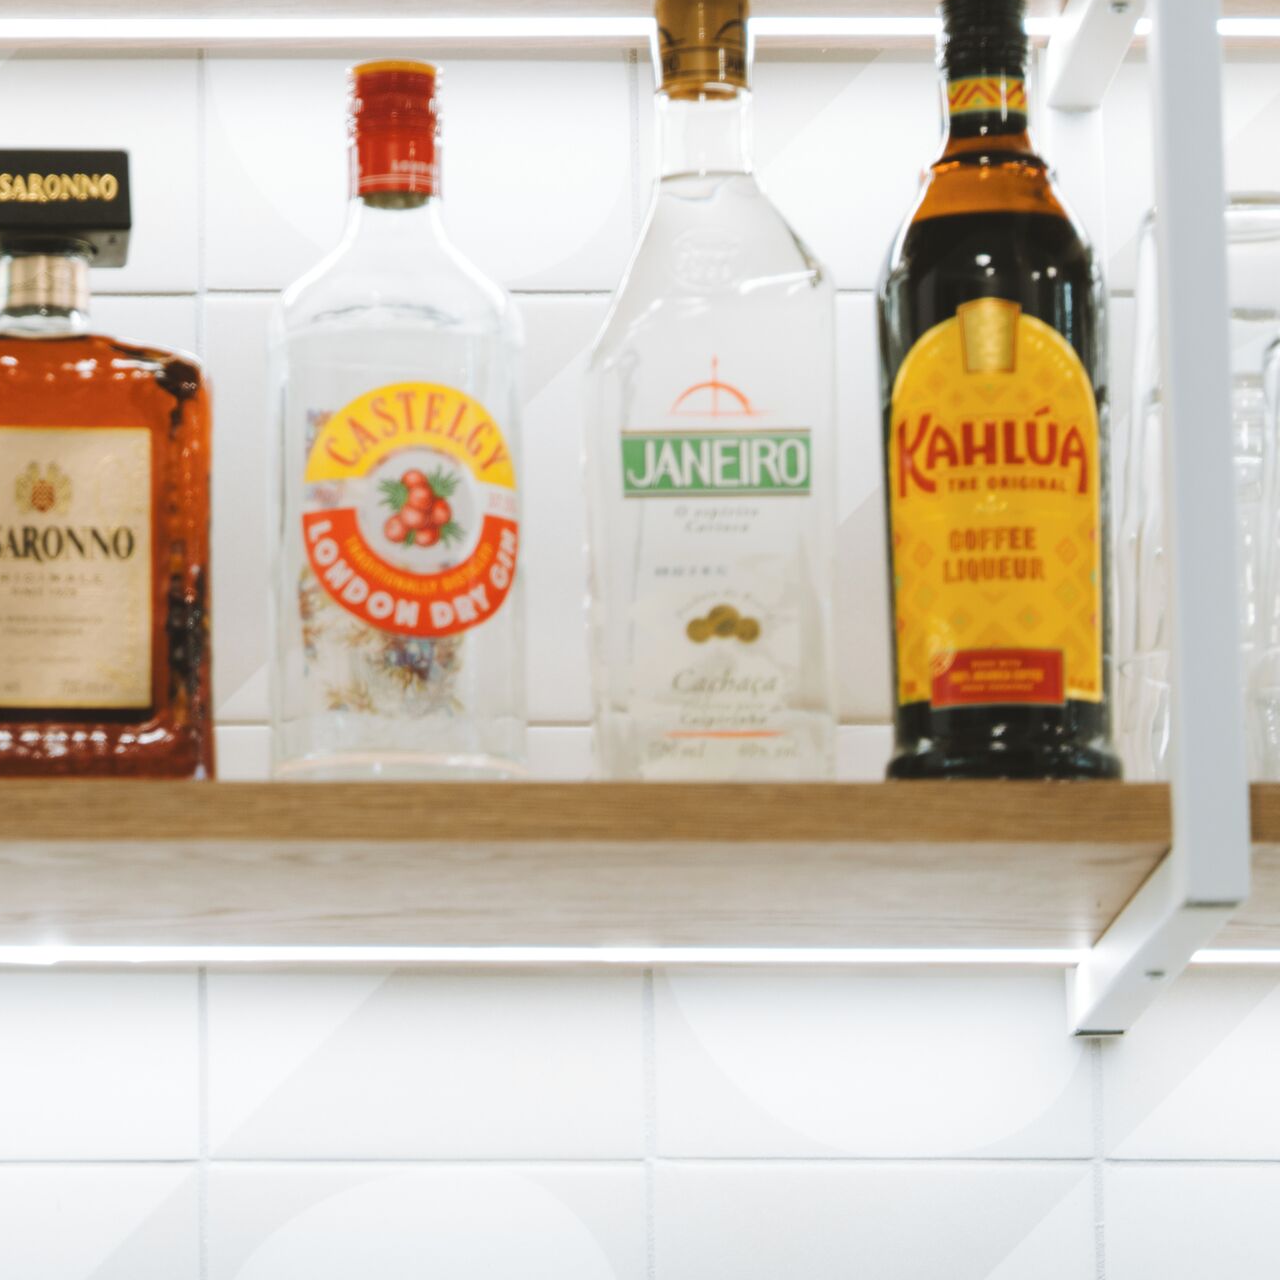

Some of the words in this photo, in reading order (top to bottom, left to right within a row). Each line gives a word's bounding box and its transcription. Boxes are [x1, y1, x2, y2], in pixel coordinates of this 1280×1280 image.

[323, 389, 505, 474] CASTELGY
[626, 438, 809, 489] JANEIRO
[897, 403, 1090, 500] KAHLÚA
[942, 557, 1047, 584] LIQUEUR
[948, 526, 1039, 553] COFFEE
[306, 518, 421, 630] LONDON
[428, 581, 491, 630] DRY
[488, 526, 518, 591] GIN
